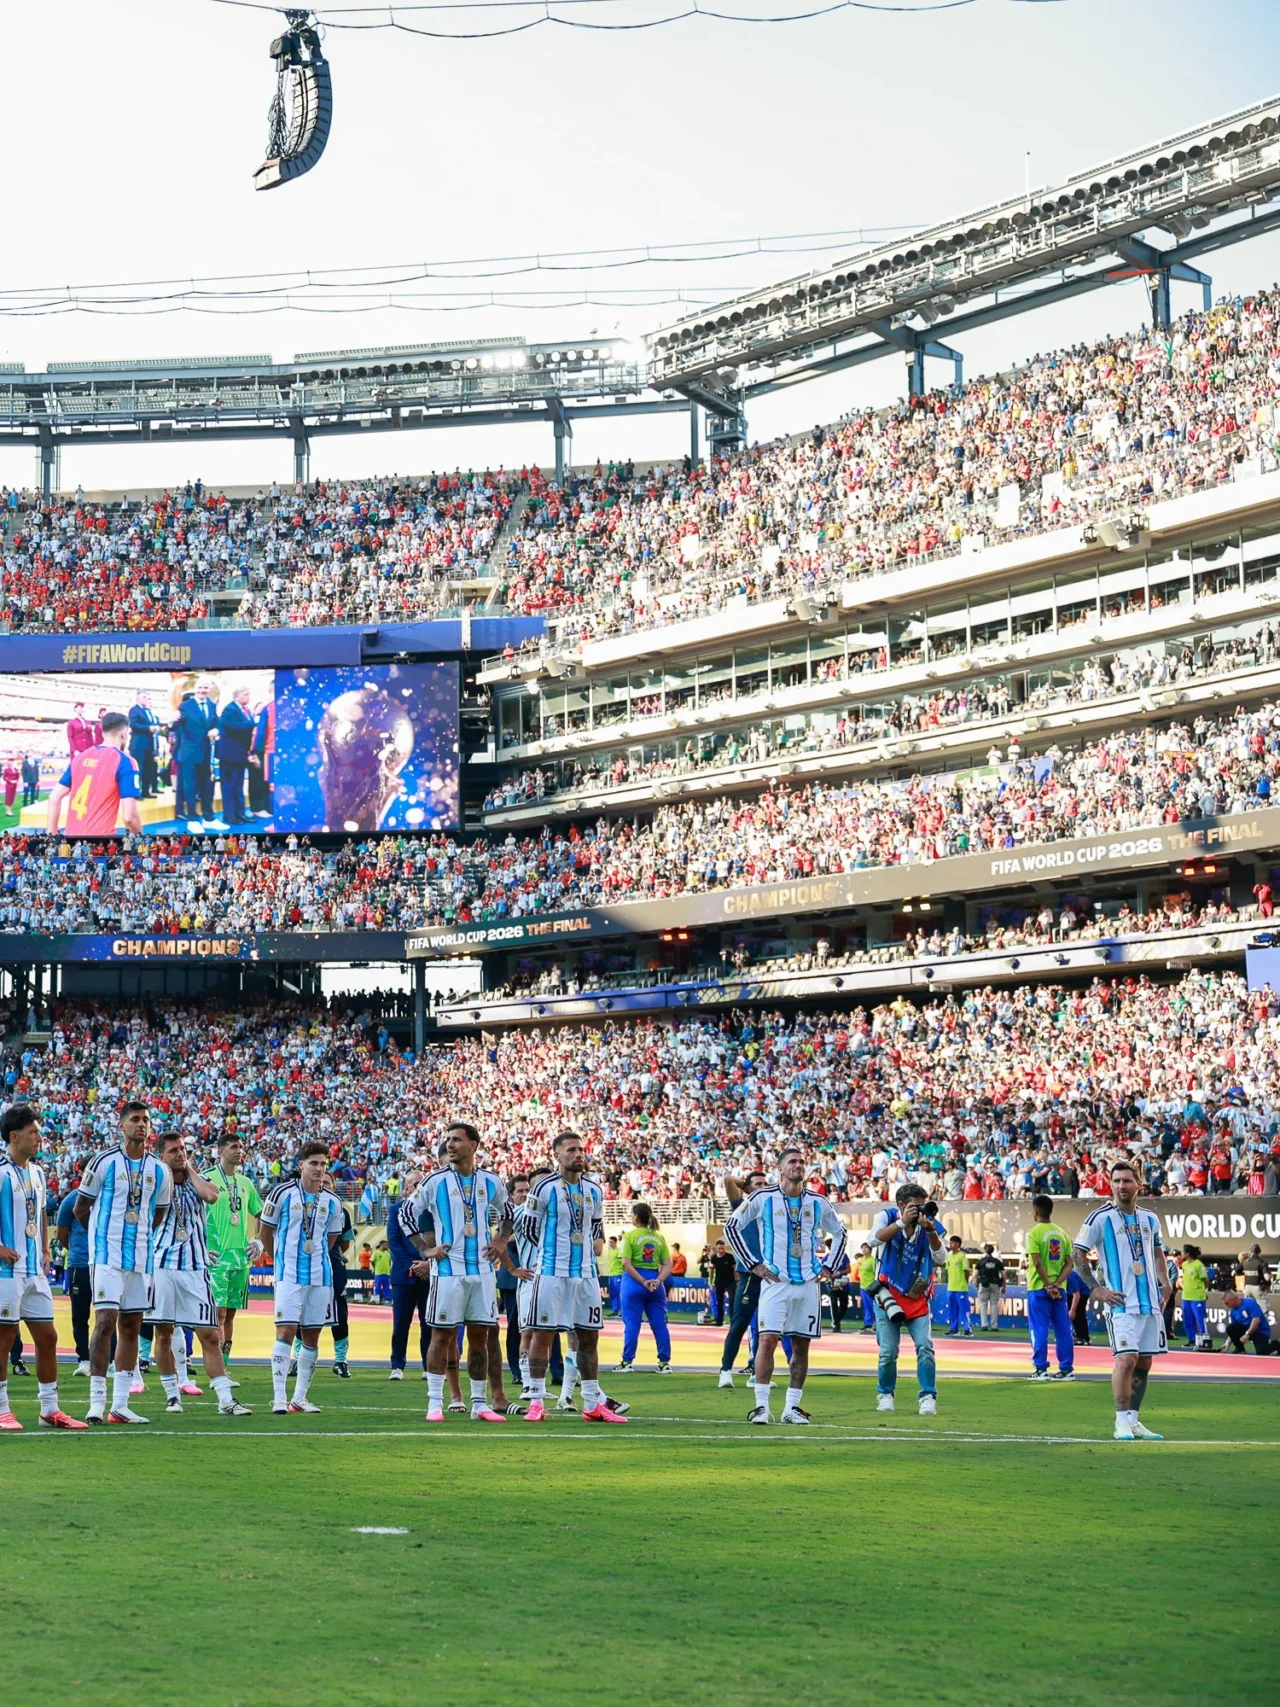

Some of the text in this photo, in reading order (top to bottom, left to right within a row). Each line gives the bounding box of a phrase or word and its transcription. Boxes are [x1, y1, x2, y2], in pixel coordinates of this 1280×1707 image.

[62, 642, 191, 664] #FIFAWorldCup
[71, 774, 92, 820] 4
[991, 821, 1263, 876] FIFA WORLD CUP 2026 THE FINAL
[724, 882, 837, 914] CHAMPIONS
[409, 917, 591, 950] FIFA WORLD CUP 2026 THE FINAL
[113, 940, 240, 955] CHAMPIONS
[1165, 1214, 1247, 1238] WORLD
[346, 1279, 362, 1288] 2026
[199, 1303, 209, 1320] 11
[588, 1307, 600, 1323] 19
[808, 1315, 816, 1332] 7
